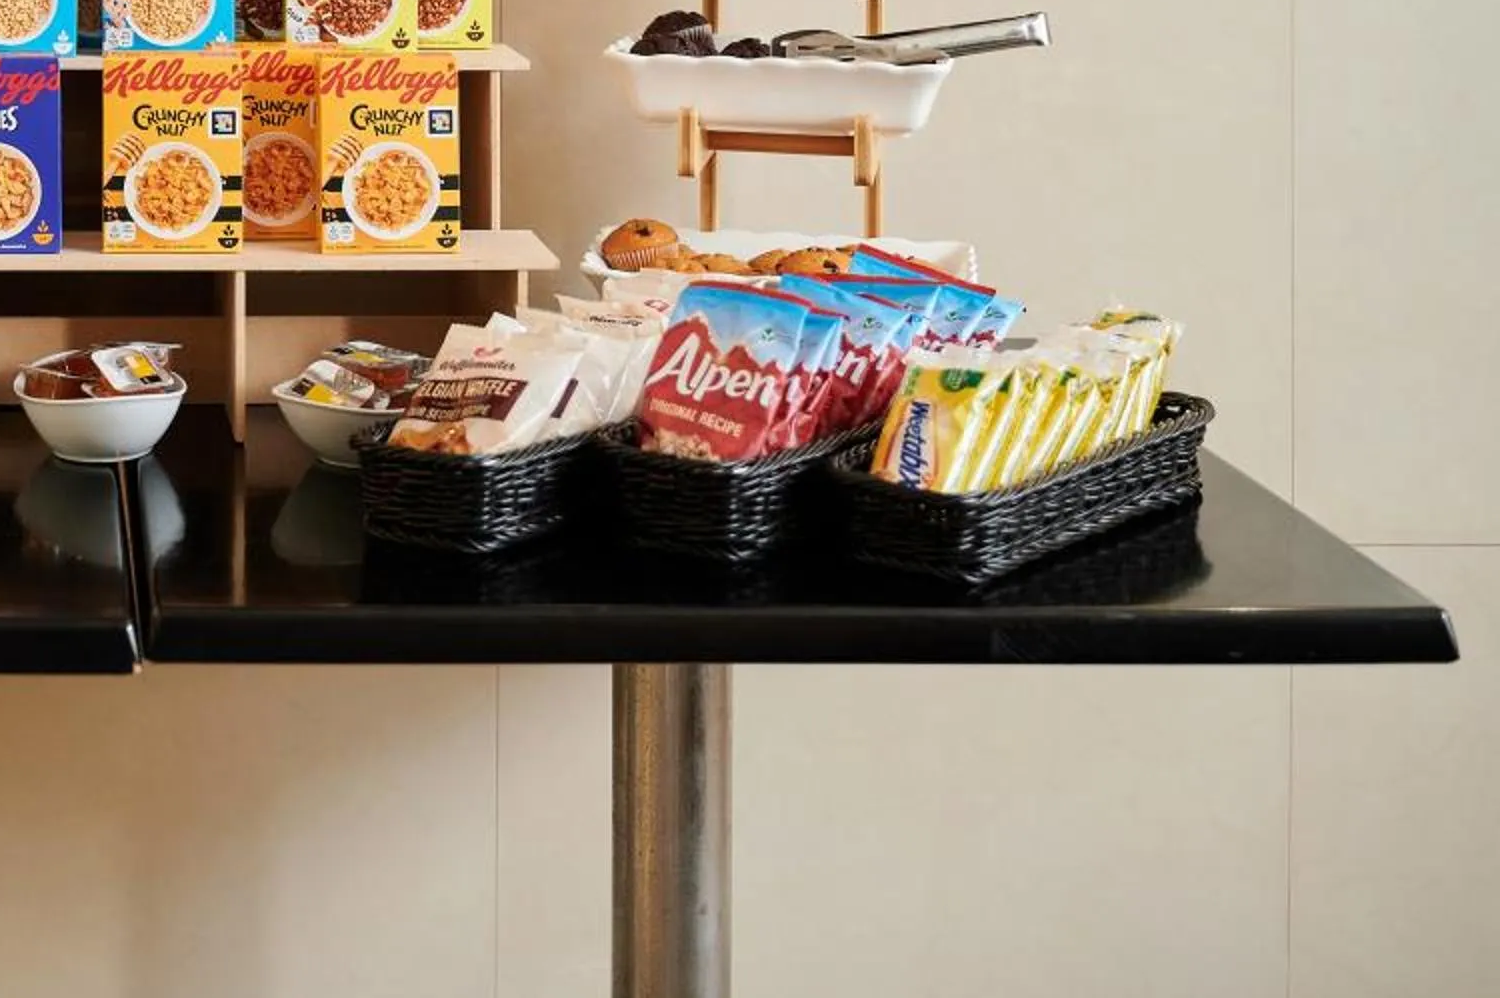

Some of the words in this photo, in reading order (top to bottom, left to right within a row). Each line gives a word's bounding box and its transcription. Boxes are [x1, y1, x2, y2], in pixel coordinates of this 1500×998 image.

[104, 57, 243, 104] Kellogg's
[321, 57, 457, 104] Kellogg's
[132, 104, 207, 130] CRUNCHY
[156, 123, 188, 137] NUT
[260, 114, 291, 127] NUT
[350, 104, 424, 130] CRUNCHY
[374, 123, 407, 136] NUT
[645, 332, 775, 408] Alpen
[416, 380, 463, 399] ELGIAN
[650, 398, 697, 422] ORIGINAL
[700, 410, 744, 438] RECIPE
